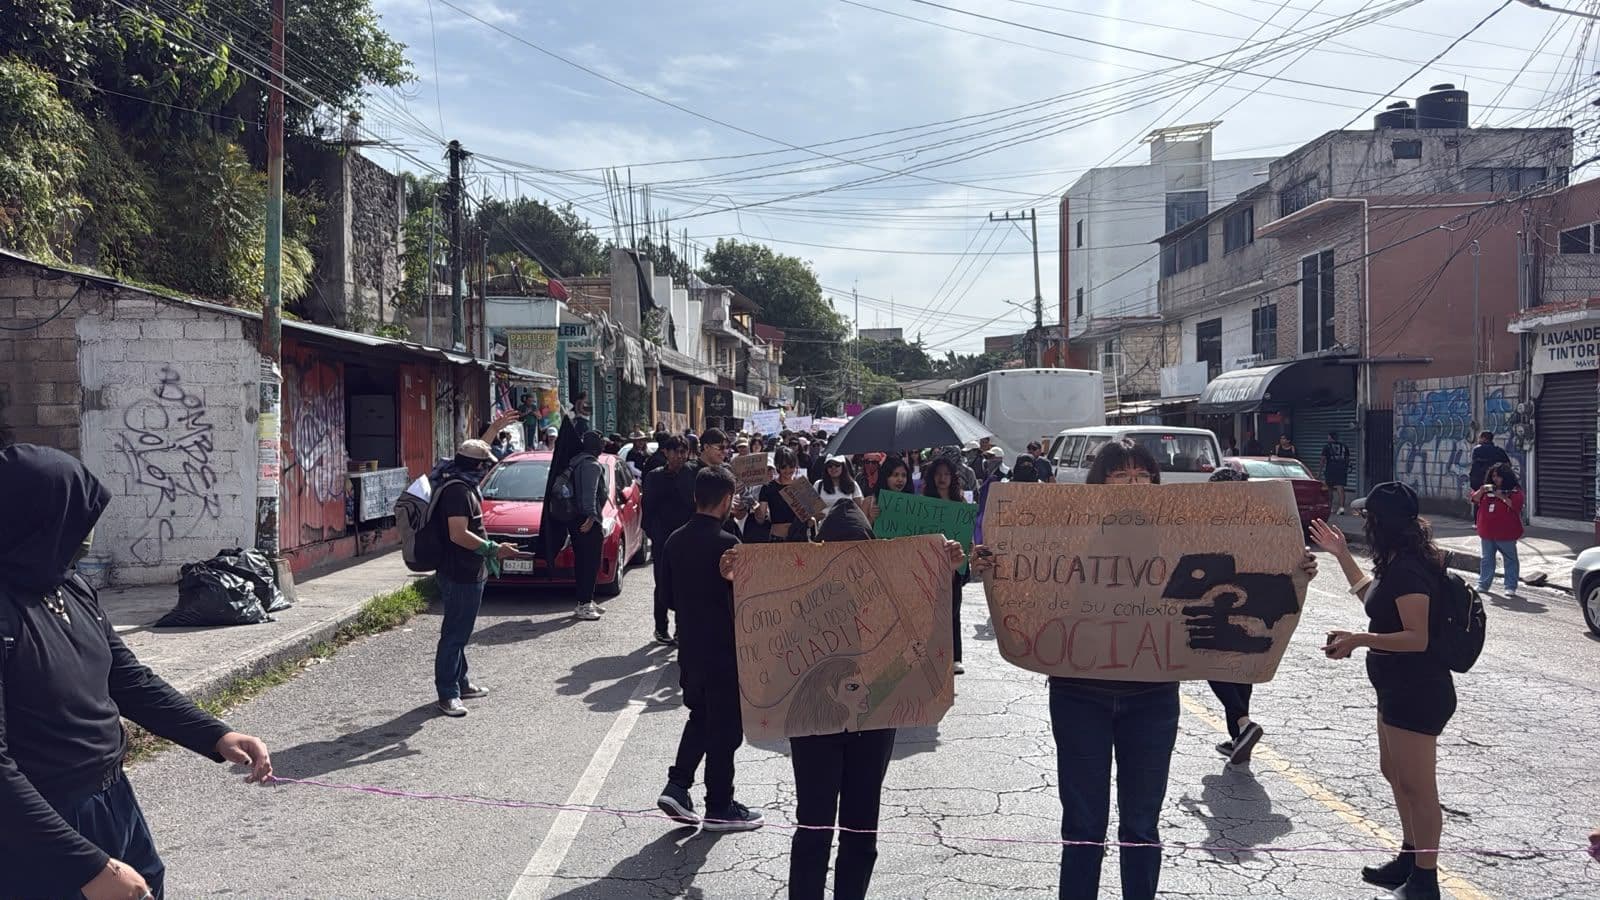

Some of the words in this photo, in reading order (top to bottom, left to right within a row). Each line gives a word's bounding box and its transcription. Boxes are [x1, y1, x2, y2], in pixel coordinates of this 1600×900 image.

[1541, 326, 1600, 346] LAVANDE
[606, 374, 617, 432] COPIAS
[1066, 499, 1187, 535] imposible
[993, 554, 1167, 589] EDUCATIVO
[1048, 591, 1070, 610] de
[1113, 597, 1178, 617] contexto
[1002, 614, 1186, 672] SOCIAL
